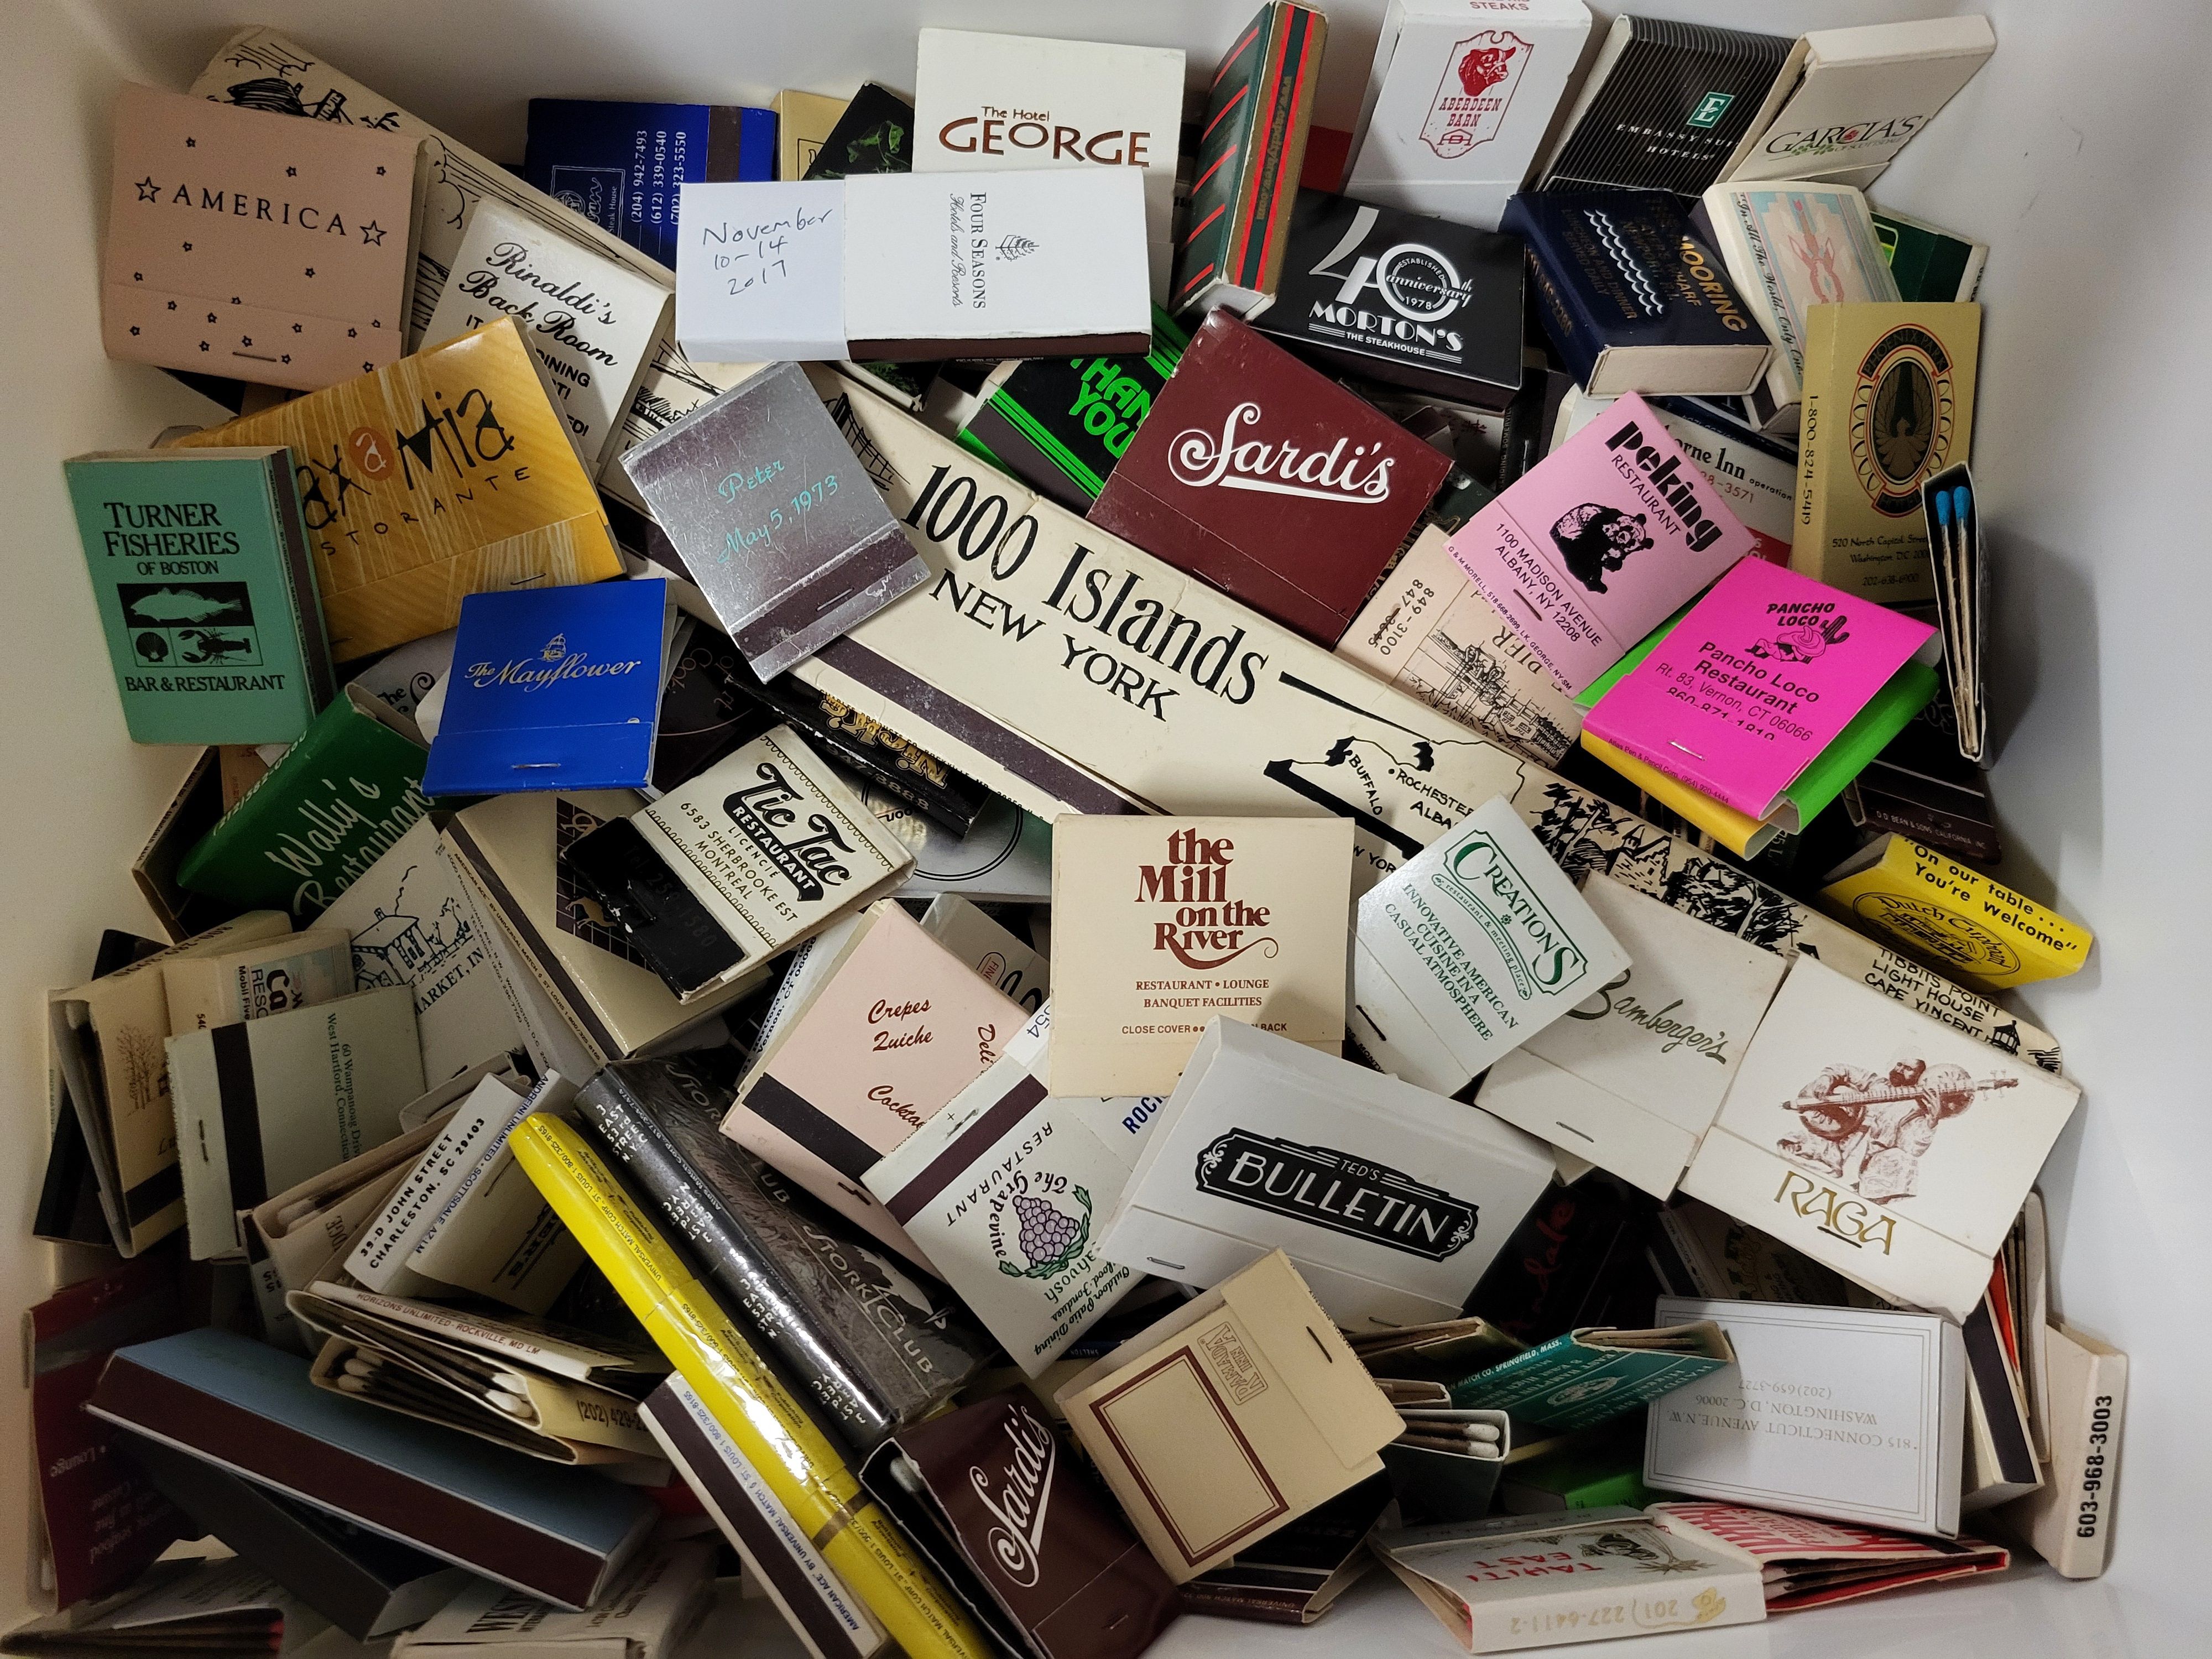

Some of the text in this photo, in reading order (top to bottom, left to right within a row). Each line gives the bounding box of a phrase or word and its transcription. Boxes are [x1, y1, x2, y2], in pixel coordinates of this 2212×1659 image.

[1470, 1, 1530, 12] STEAKS
[982, 106, 1050, 122] The Hotel
[1439, 97, 1503, 112] ABERDEEN
[1447, 113, 1480, 128] BARN
[939, 117, 1151, 168] GEORGE
[1616, 123, 1698, 143] EMBASSY
[1646, 145, 1709, 160] HOTELS
[1765, 113, 1924, 155] GARCIA'S
[631, 129, 648, 223] (204) 942-7493
[650, 131, 667, 224] (612) 339-0540
[672, 131, 687, 188] 323-5550
[173, 184, 347, 237] AMERICA
[609, 185, 617, 209] House
[702, 207, 833, 247] November
[950, 192, 964, 308] Hotels and Resorts
[971, 191, 987, 310] FOUR SEASONS
[714, 237, 789, 270] 10-14
[727, 260, 787, 295] 2017
[1398, 258, 1446, 281] ESTABLISHED
[486, 242, 616, 326] Rinaldi's
[1385, 272, 1474, 309] anniversary
[1404, 295, 1433, 311] 1978
[458, 270, 618, 367] Back Room
[1308, 300, 1463, 352] MORTON'S
[1346, 332, 1426, 357] THE STEAKHOUSE
[1863, 330, 1948, 374] PHOENIX PARK
[1167, 401, 1396, 504] Sardi's
[1715, 447, 1792, 501] Inn operation
[1801, 395, 1818, 524] 1-800-824-5419
[718, 460, 786, 504] Peter
[1604, 421, 1723, 552] peking
[1610, 454, 1683, 536] RESTAURANT
[103, 502, 222, 530] TURNER
[718, 474, 839, 564] May 5, 1973
[900, 463, 1039, 582] 1000
[103, 531, 241, 557] FISHERIES
[137, 561, 220, 576] OF BOSTON
[1832, 539, 1848, 547] 520
[1494, 544, 1581, 643] ALBANY, NY 12208
[1496, 523, 1603, 648] 1100 MADISON AVENUE
[1767, 602, 1835, 615] PANCHO
[928, 567, 1181, 723] NEW YORK
[1042, 541, 1270, 706] Islands
[1777, 614, 1819, 628] LOCO
[124, 675, 285, 692] BAR RESTAURANT
[464, 661, 497, 688] The
[474, 651, 641, 692] Mayflower
[1693, 659, 1799, 716] Restaurant
[1698, 641, 1820, 704] Pancho Loco
[1655, 662, 1814, 743] Rt. 83, Vernon, 06066
[1346, 749, 1384, 816] BUFFALO
[264, 776, 381, 877] Wally's
[732, 806, 815, 891] RESTAURANT
[755, 761, 854, 887] Tic Tac
[1167, 827, 1234, 865] the
[681, 802, 799, 924] 6583 SHERBROOKE EST
[694, 839, 755, 900] MONTREAL
[728, 827, 780, 878] LICENCIÉ
[451, 853, 525, 950] AMERICAN UNIVERSAL
[1134, 865, 1227, 902] Mill
[1444, 884, 1484, 928] restaurant
[1914, 862, 1971, 901] You're
[1983, 900, 2078, 951] welcome"
[1949, 865, 2033, 915] our table
[1175, 899, 1271, 927] on the
[1451, 841, 1580, 986] CREATIONS
[468, 948, 487, 969] IN
[1153, 922, 1261, 968] River
[1401, 883, 1520, 1030] INNOVATIVE AMERICAN
[1416, 922, 1462, 980] CUISINE
[1136, 979, 1270, 991] RESTAURANT LOUNGE
[1384, 902, 1494, 1042] CASUAL ATMOSPHERE
[1864, 972, 1905, 1001] CAPE
[1872, 959, 1986, 1024] LIGHT HOUSE
[1876, 947, 2001, 1016] TIBBITS POINT
[868, 998, 931, 1025] Crepes
[1121, 1022, 1287, 1035] CLOSE COVER BACK
[1144, 997, 1262, 1009] BANQUET FACILITIES
[1566, 969, 1728, 1066] Bamberger's
[873, 1029, 933, 1053] Quiche
[977, 1023, 996, 1065] Deli
[345, 1061, 357, 1126] Wampanoag
[482, 1114, 523, 1163] UNLIMITED
[538, 1124, 579, 1174] 1-800/325-8165
[358, 1133, 456, 1258] 39-D JOHN STREET
[368, 1116, 488, 1270] CHARLESTON, SC 29403
[575, 1172, 594, 1193] LOUIS
[946, 1121, 1053, 1228] RESTAURANT
[1340, 1159, 1380, 1181] TED'S
[988, 1171, 1068, 1259] The Grapevine
[1227, 1150, 1450, 1244] BULLETIN
[1773, 1169, 1897, 1256] RAGA
[614, 1220, 636, 1246] MATCH
[632, 1243, 664, 1281] UNIVERSAL
[802, 1224, 870, 1307] STORK
[1034, 1266, 1130, 1355] Outdoor Patio Dining
[1206, 1324, 1265, 1401] RAMADA INN
[1495, 1339, 1563, 1375] SPRINGFIELD, MASS.
[1739, 1379, 1832, 1399] (202)659-3727
[1768, 1398, 1878, 1426] WASHINGTON,
[1765, 1424, 1884, 1447] CONNECTICUT
[2077, 1395, 2114, 1538] 603-968-3003
[969, 1404, 1056, 1589] Sardi's
[753, 1488, 861, 1632] AMERICAN UNIVERSAL MATCH
